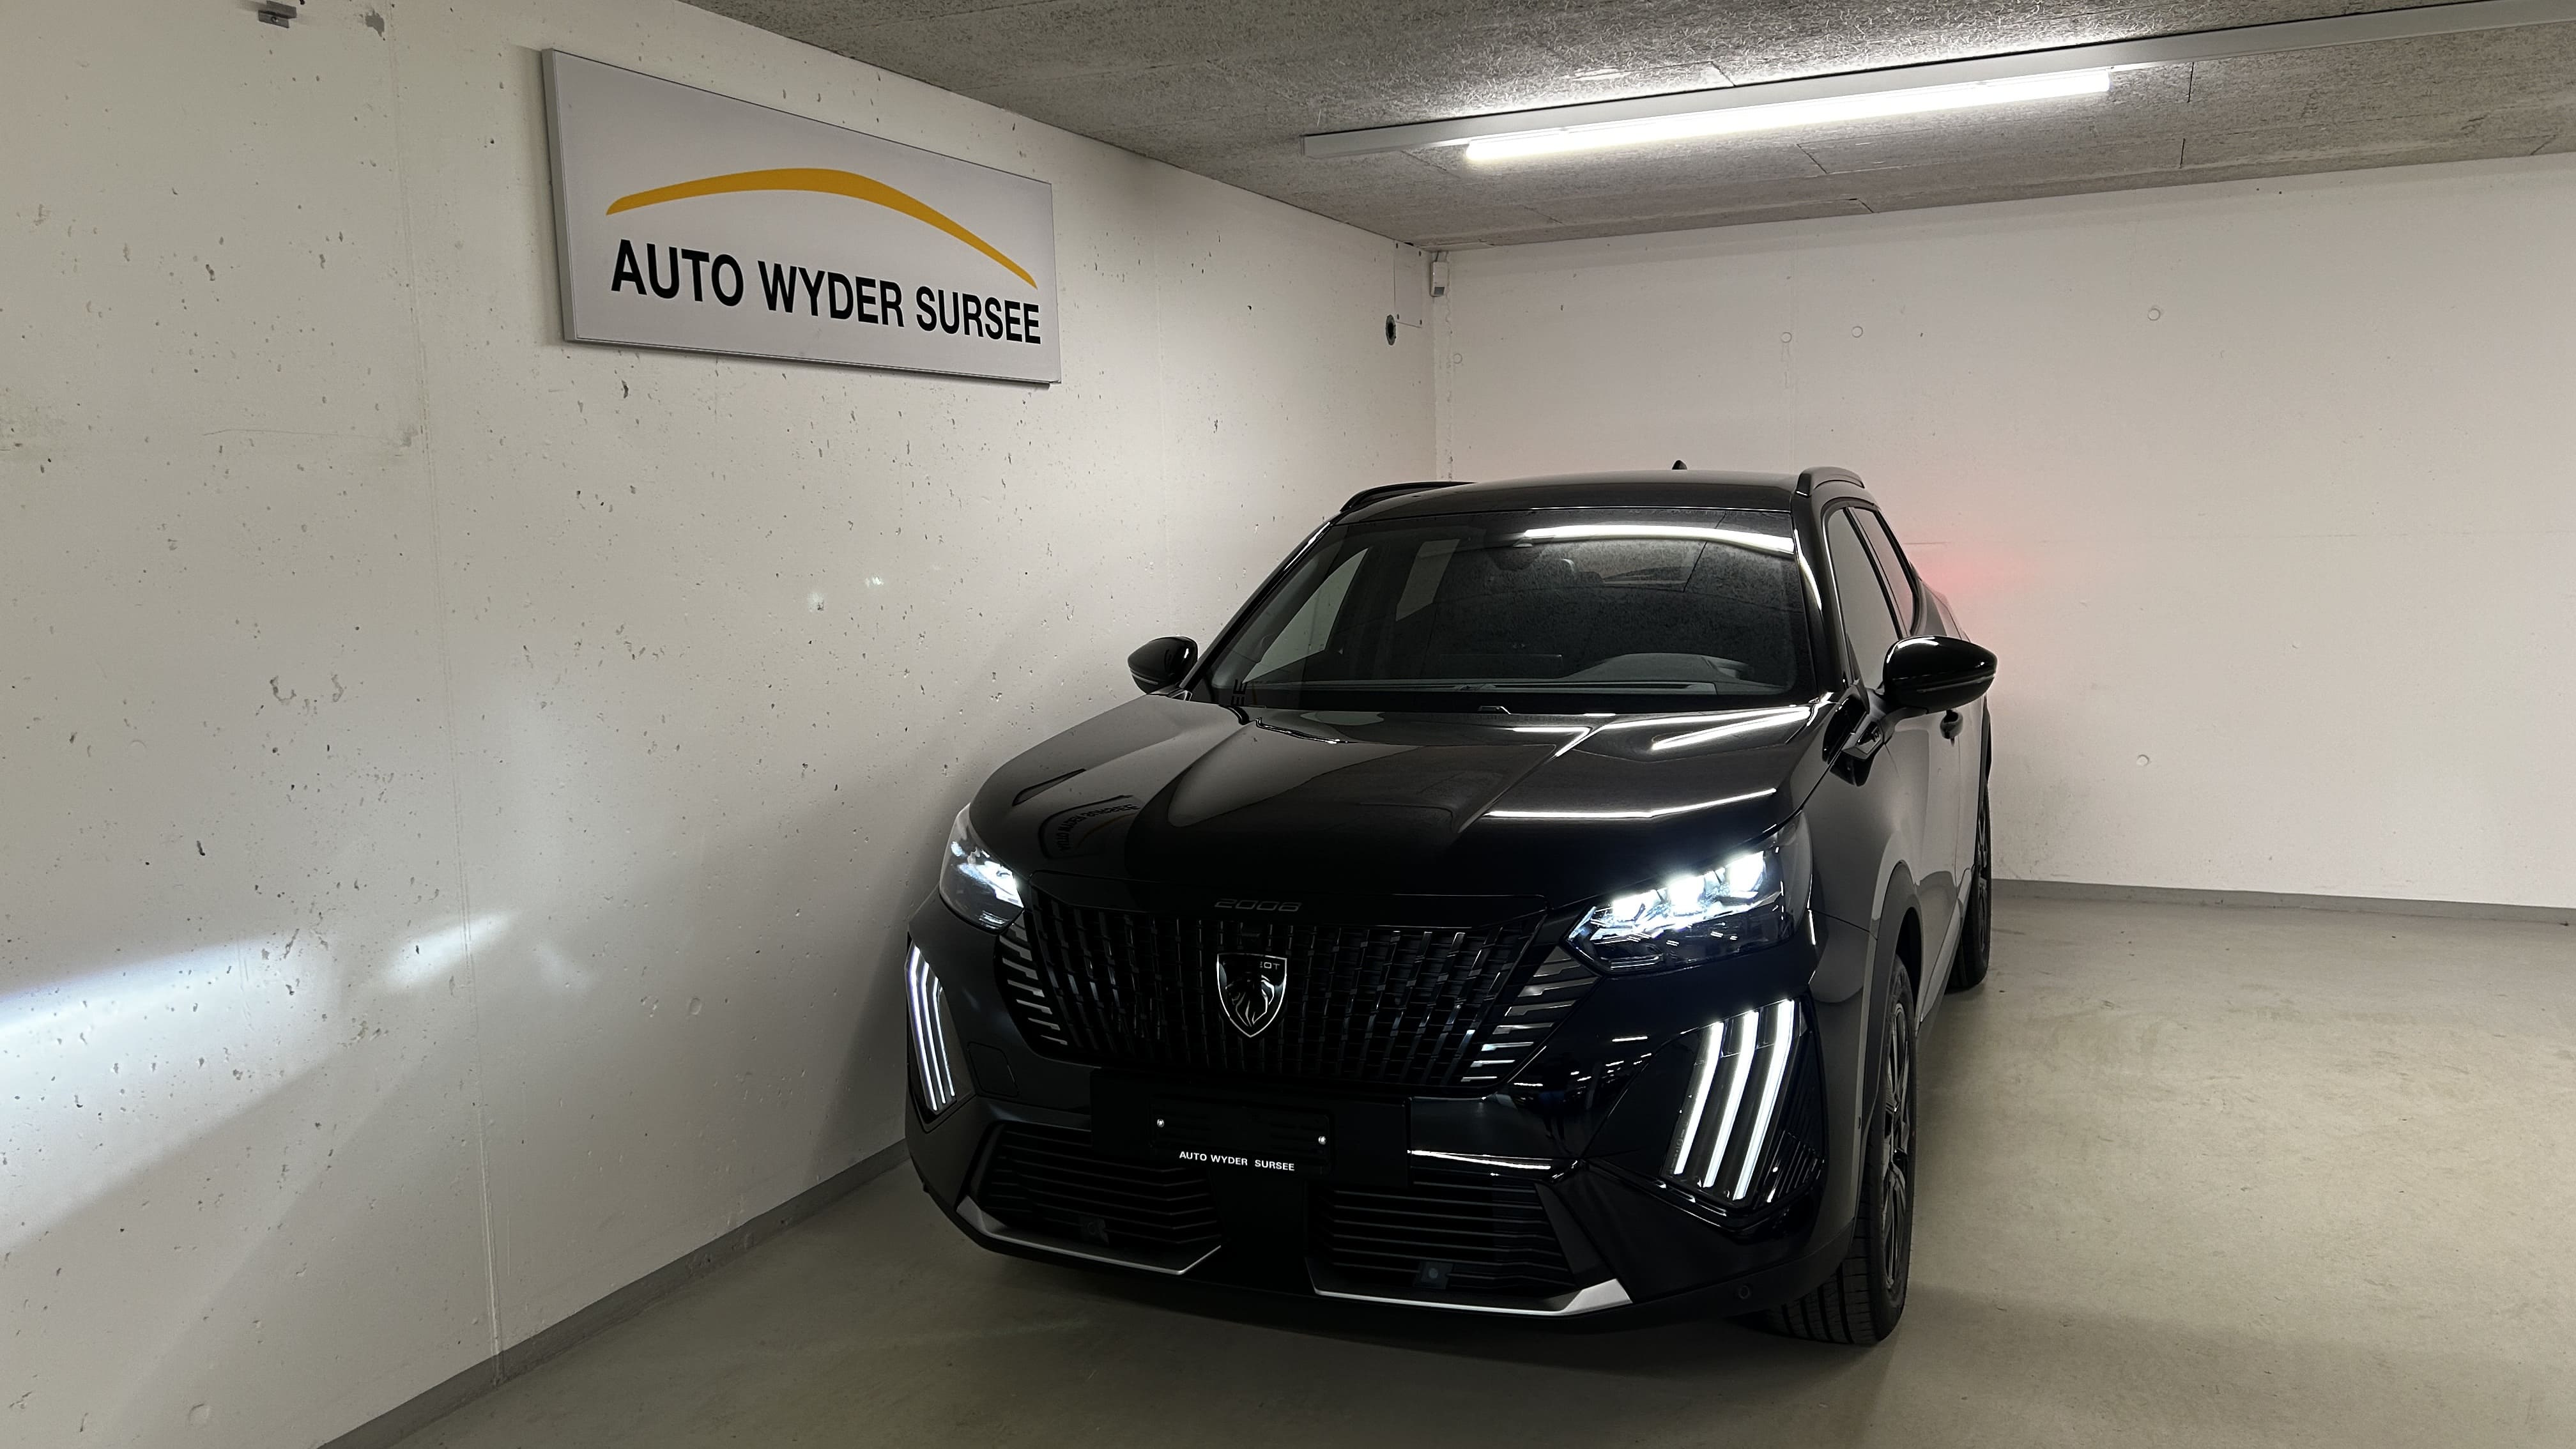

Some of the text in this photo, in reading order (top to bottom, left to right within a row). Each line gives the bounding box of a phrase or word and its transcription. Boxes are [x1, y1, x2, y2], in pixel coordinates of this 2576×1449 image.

[611, 240, 1040, 344] AUTO WYDER SURSEE
[1215, 899, 1301, 912] 2008
[1179, 1151, 1294, 1171] AUTO WYDER SURSEE
